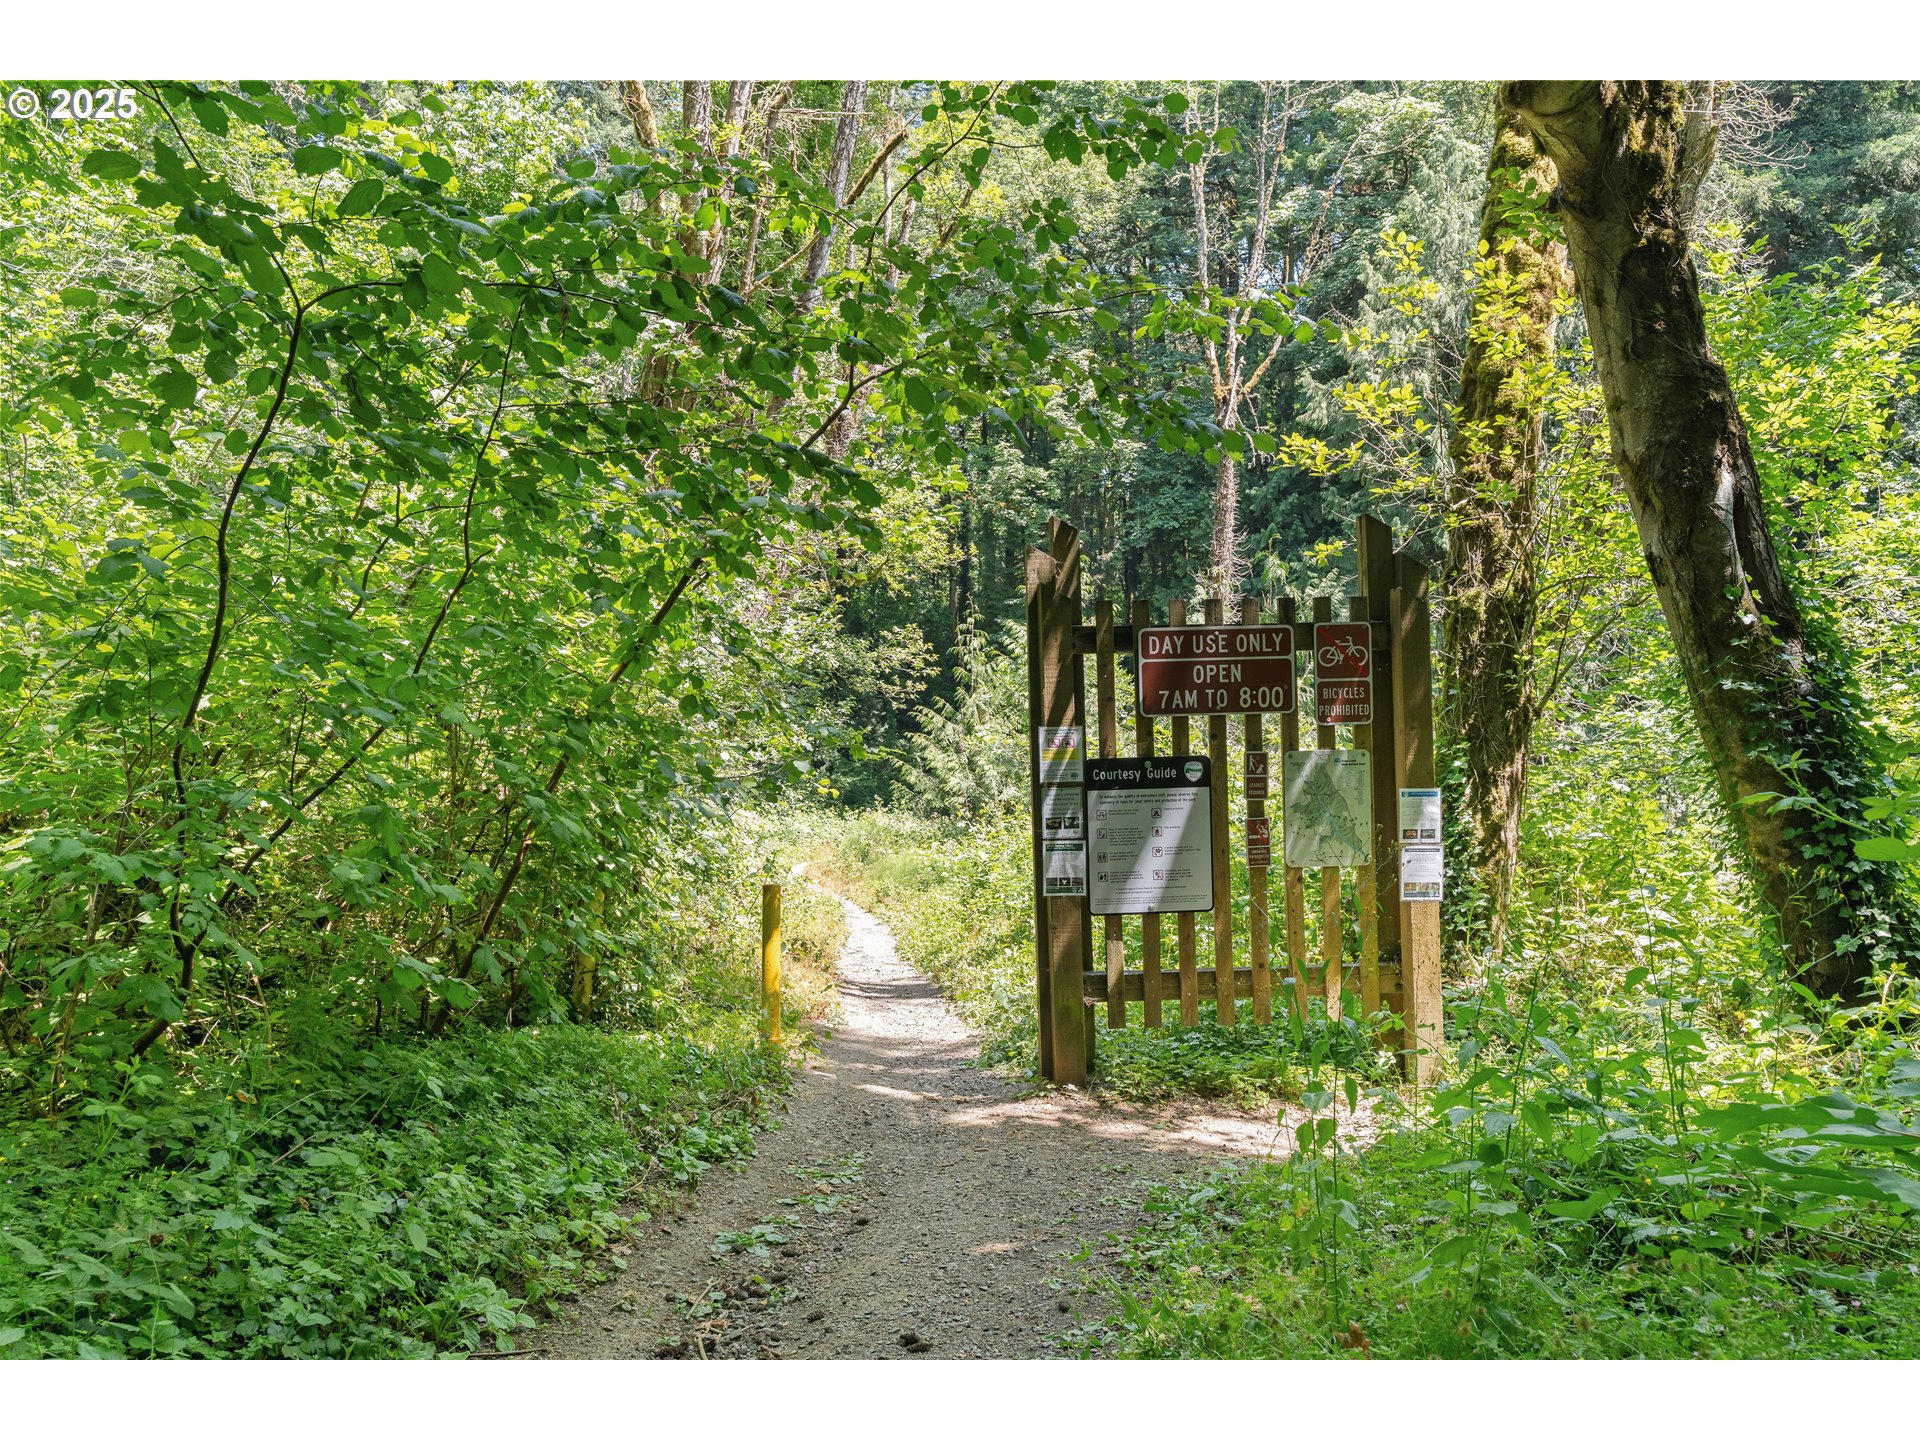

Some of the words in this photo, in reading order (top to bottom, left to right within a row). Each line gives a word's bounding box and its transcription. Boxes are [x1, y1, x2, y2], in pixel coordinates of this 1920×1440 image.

[1149, 635, 1184, 655] DAY
[1192, 634, 1228, 653] USE
[1236, 633, 1283, 653] ONLY
[1193, 664, 1242, 684] OPEN
[1159, 690, 1198, 709] 7AM
[1205, 689, 1228, 708] TO
[1239, 687, 1284, 708] 8:00
[1323, 687, 1365, 699] BICYCLES
[1319, 704, 1370, 716] PROHIBITED
[1093, 769, 1141, 782] Courtesy
[1147, 767, 1177, 779] Guide
